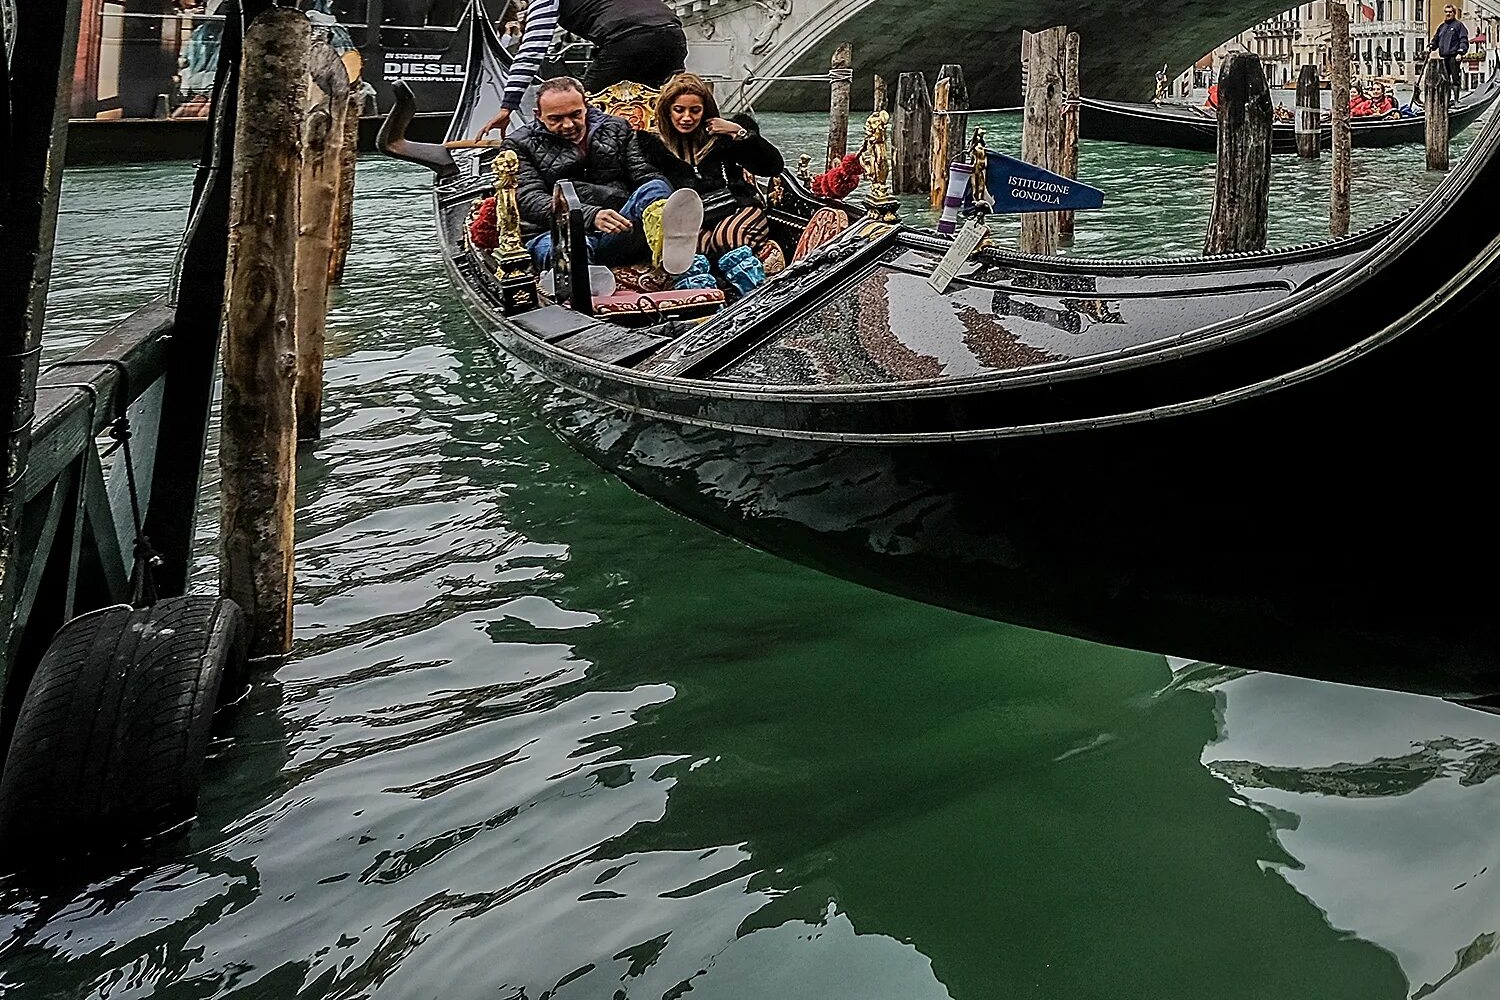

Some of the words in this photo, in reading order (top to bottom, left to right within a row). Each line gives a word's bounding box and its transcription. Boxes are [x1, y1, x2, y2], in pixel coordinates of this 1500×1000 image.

[384, 62, 466, 75] DIESEL
[1008, 176, 1069, 194] ISTITUZIONE
[1011, 188, 1060, 204] GONDOLA
